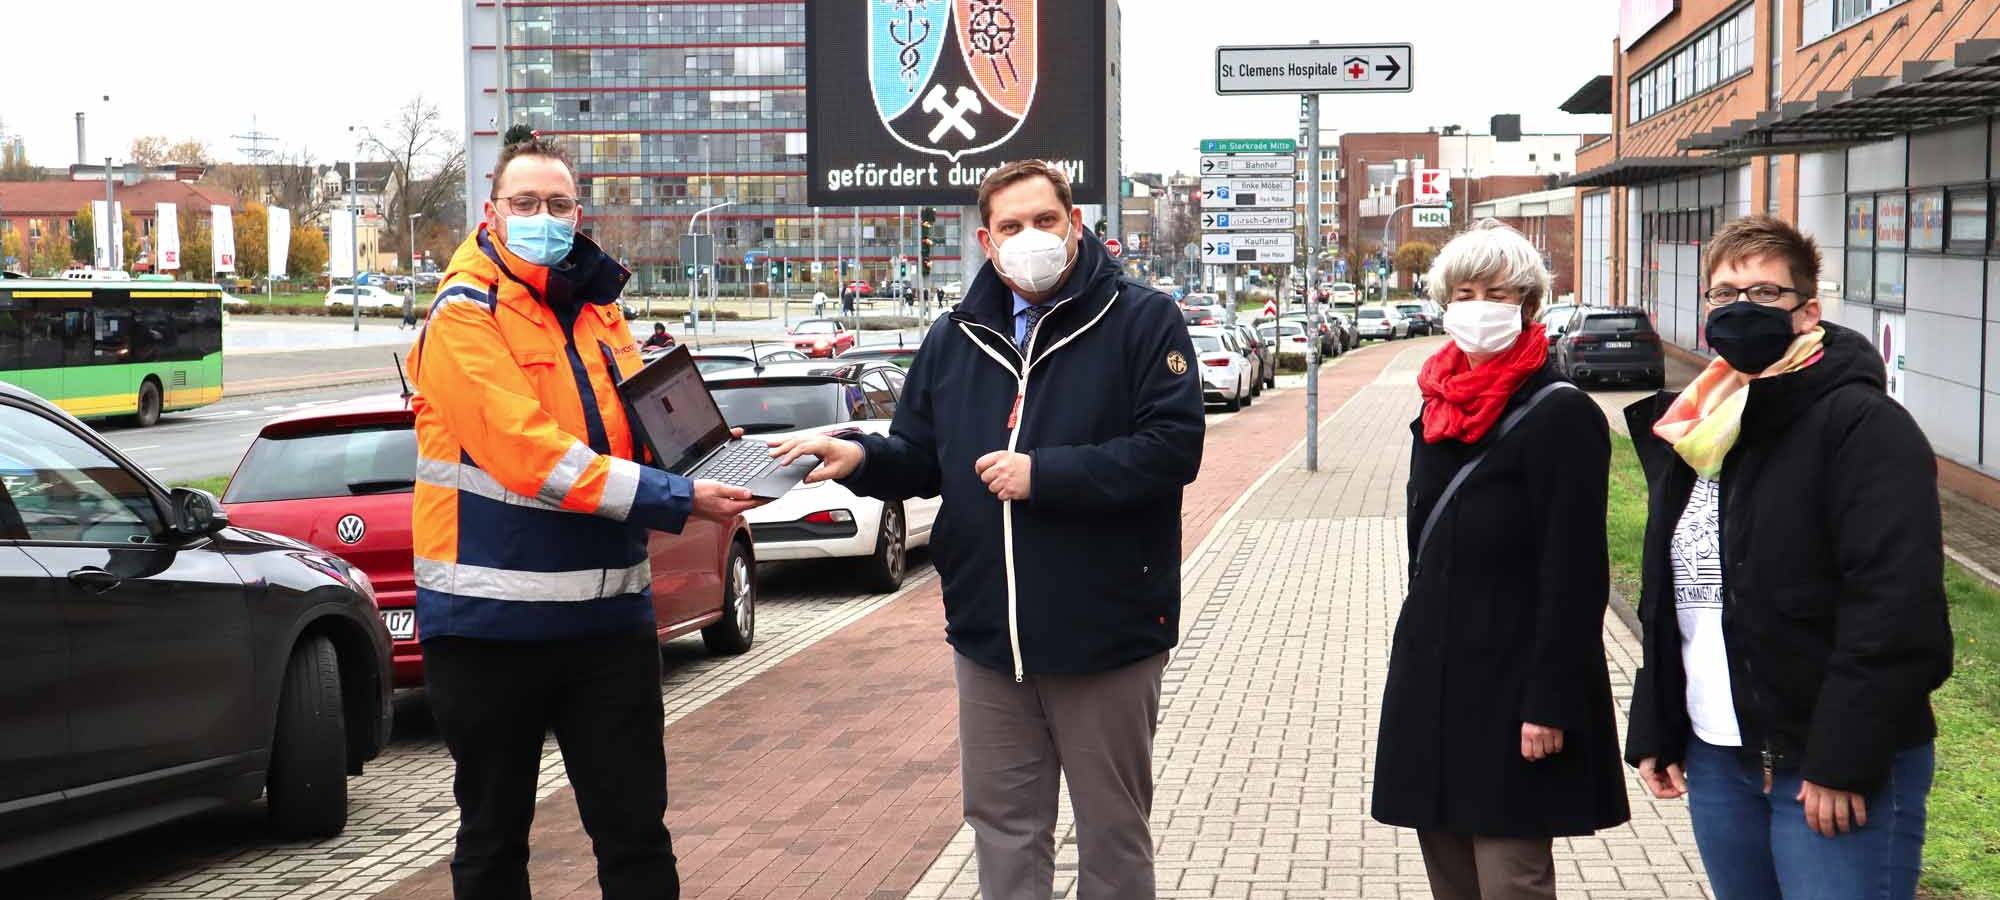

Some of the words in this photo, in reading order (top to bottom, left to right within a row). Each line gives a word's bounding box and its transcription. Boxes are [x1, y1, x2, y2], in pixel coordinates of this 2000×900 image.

[1222, 64, 1235, 77] St.
[1239, 63, 1285, 77] Clemens
[1288, 62, 1338, 79] Hospitale
[1229, 142, 1267, 150] Sterkrade
[1270, 142, 1290, 150] Mitte
[1245, 161, 1278, 169] Bahnhof
[827, 163, 938, 191] gefördert
[947, 161, 1004, 185] durc
[1418, 212, 1444, 222] HDI
